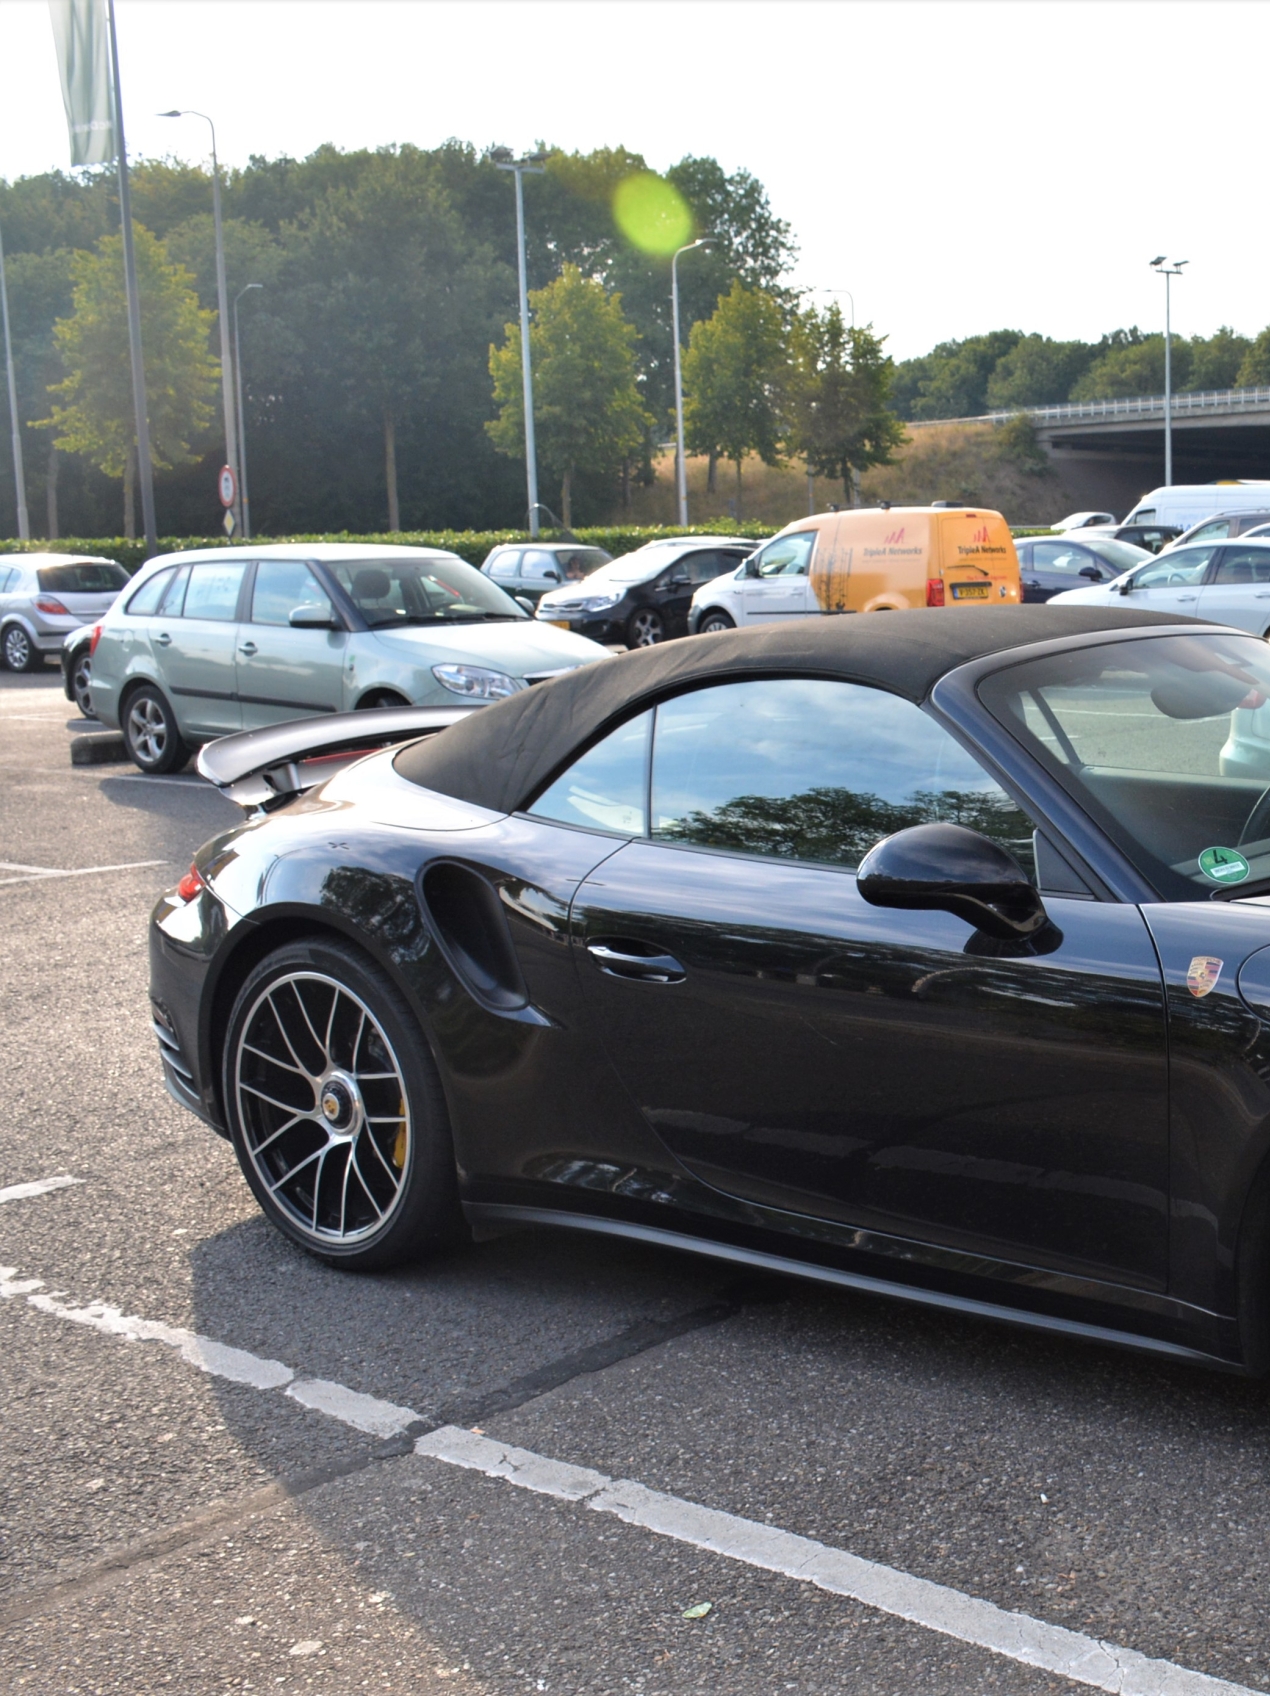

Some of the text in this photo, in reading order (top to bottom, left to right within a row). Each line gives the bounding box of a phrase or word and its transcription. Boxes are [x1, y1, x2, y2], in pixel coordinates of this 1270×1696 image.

[958, 545, 1007, 556] TripleA Networks
[1213, 849, 1228, 865] 4
